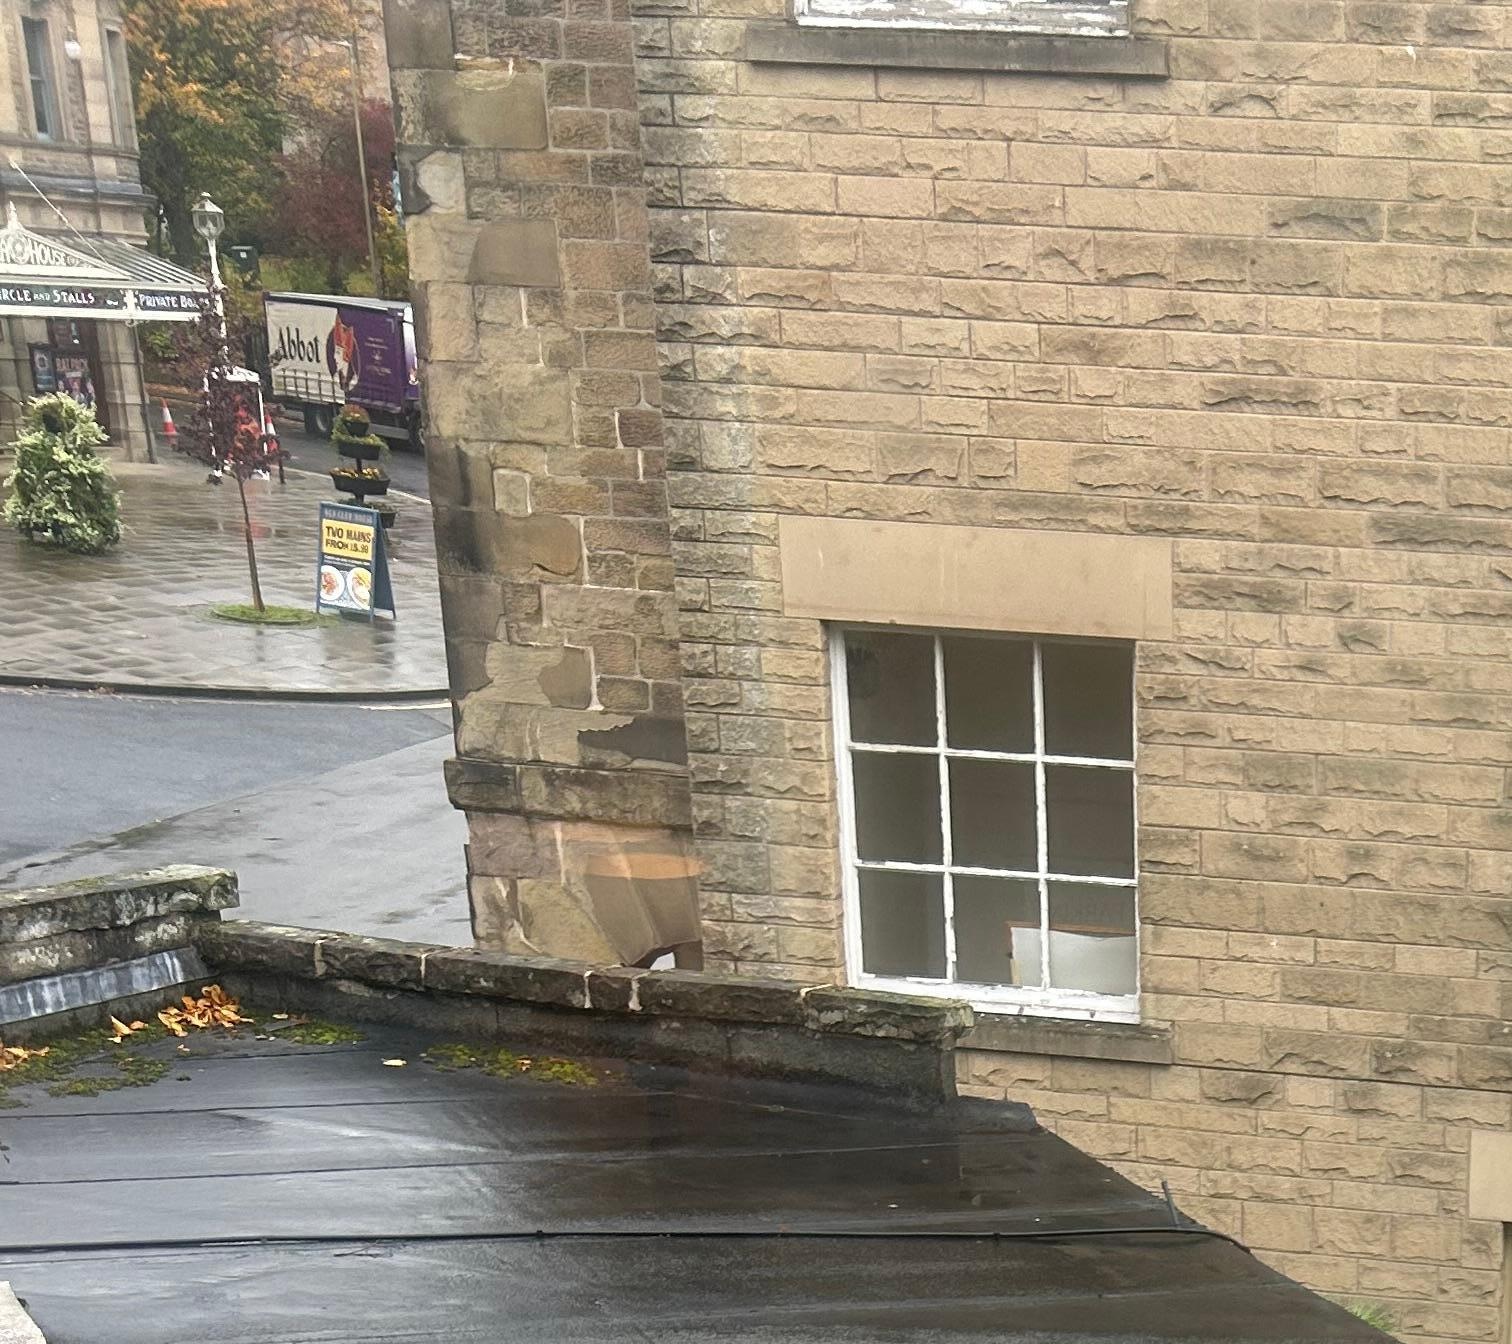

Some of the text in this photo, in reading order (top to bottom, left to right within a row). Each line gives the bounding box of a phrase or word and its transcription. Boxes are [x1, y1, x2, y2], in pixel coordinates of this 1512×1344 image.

[28, 238, 67, 266] HOUSE
[33, 292, 51, 301] AND
[52, 289, 95, 304] STALLS
[139, 293, 178, 308] PRIVATE
[277, 326, 321, 363] Abbot
[325, 525, 372, 544] TWO MAINS
[325, 538, 349, 550] FROM
